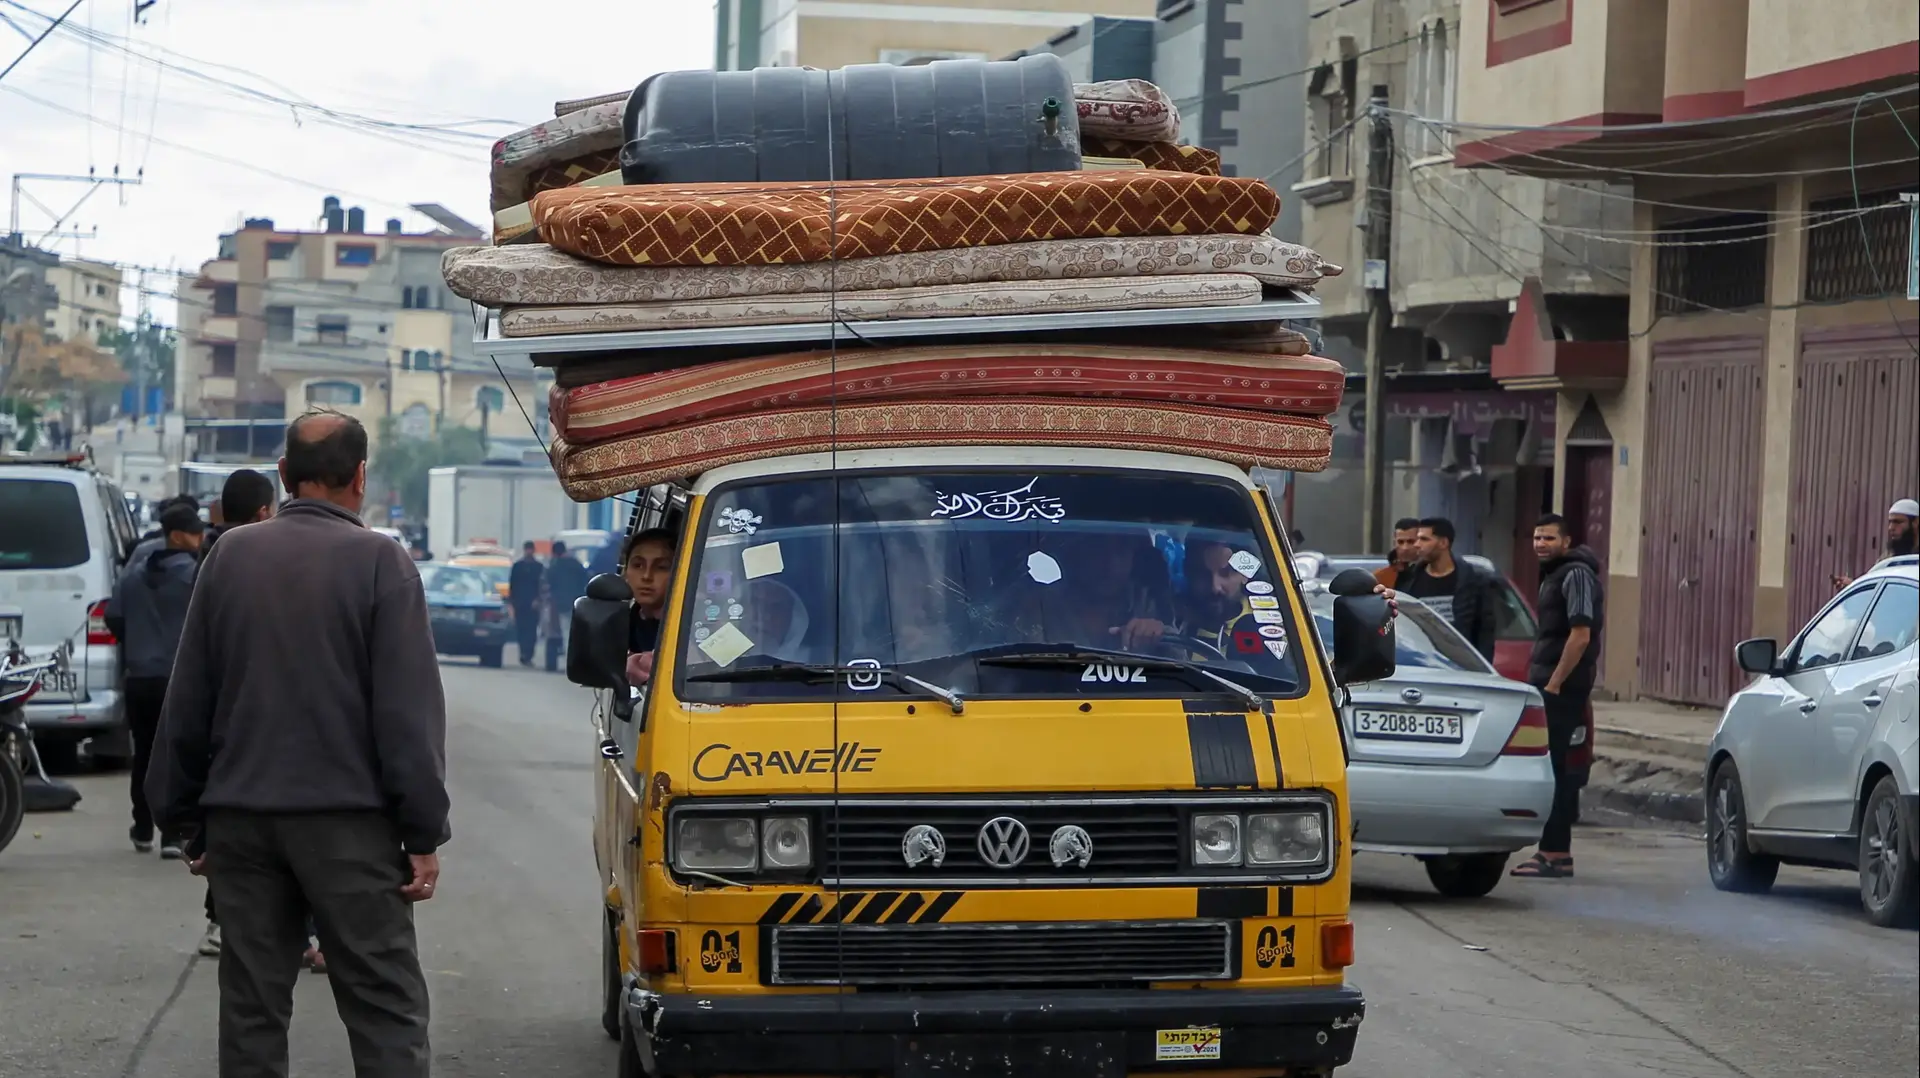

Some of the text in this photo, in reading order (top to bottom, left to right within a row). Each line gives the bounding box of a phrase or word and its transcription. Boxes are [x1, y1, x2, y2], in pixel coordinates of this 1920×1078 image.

[1081, 663, 1147, 683] 2002
[1361, 712, 1445, 735] 3-2088-03
[701, 929, 742, 973] 01
[702, 946, 739, 966] Sport
[1256, 925, 1296, 968] 01
[1257, 941, 1292, 962] Sport
